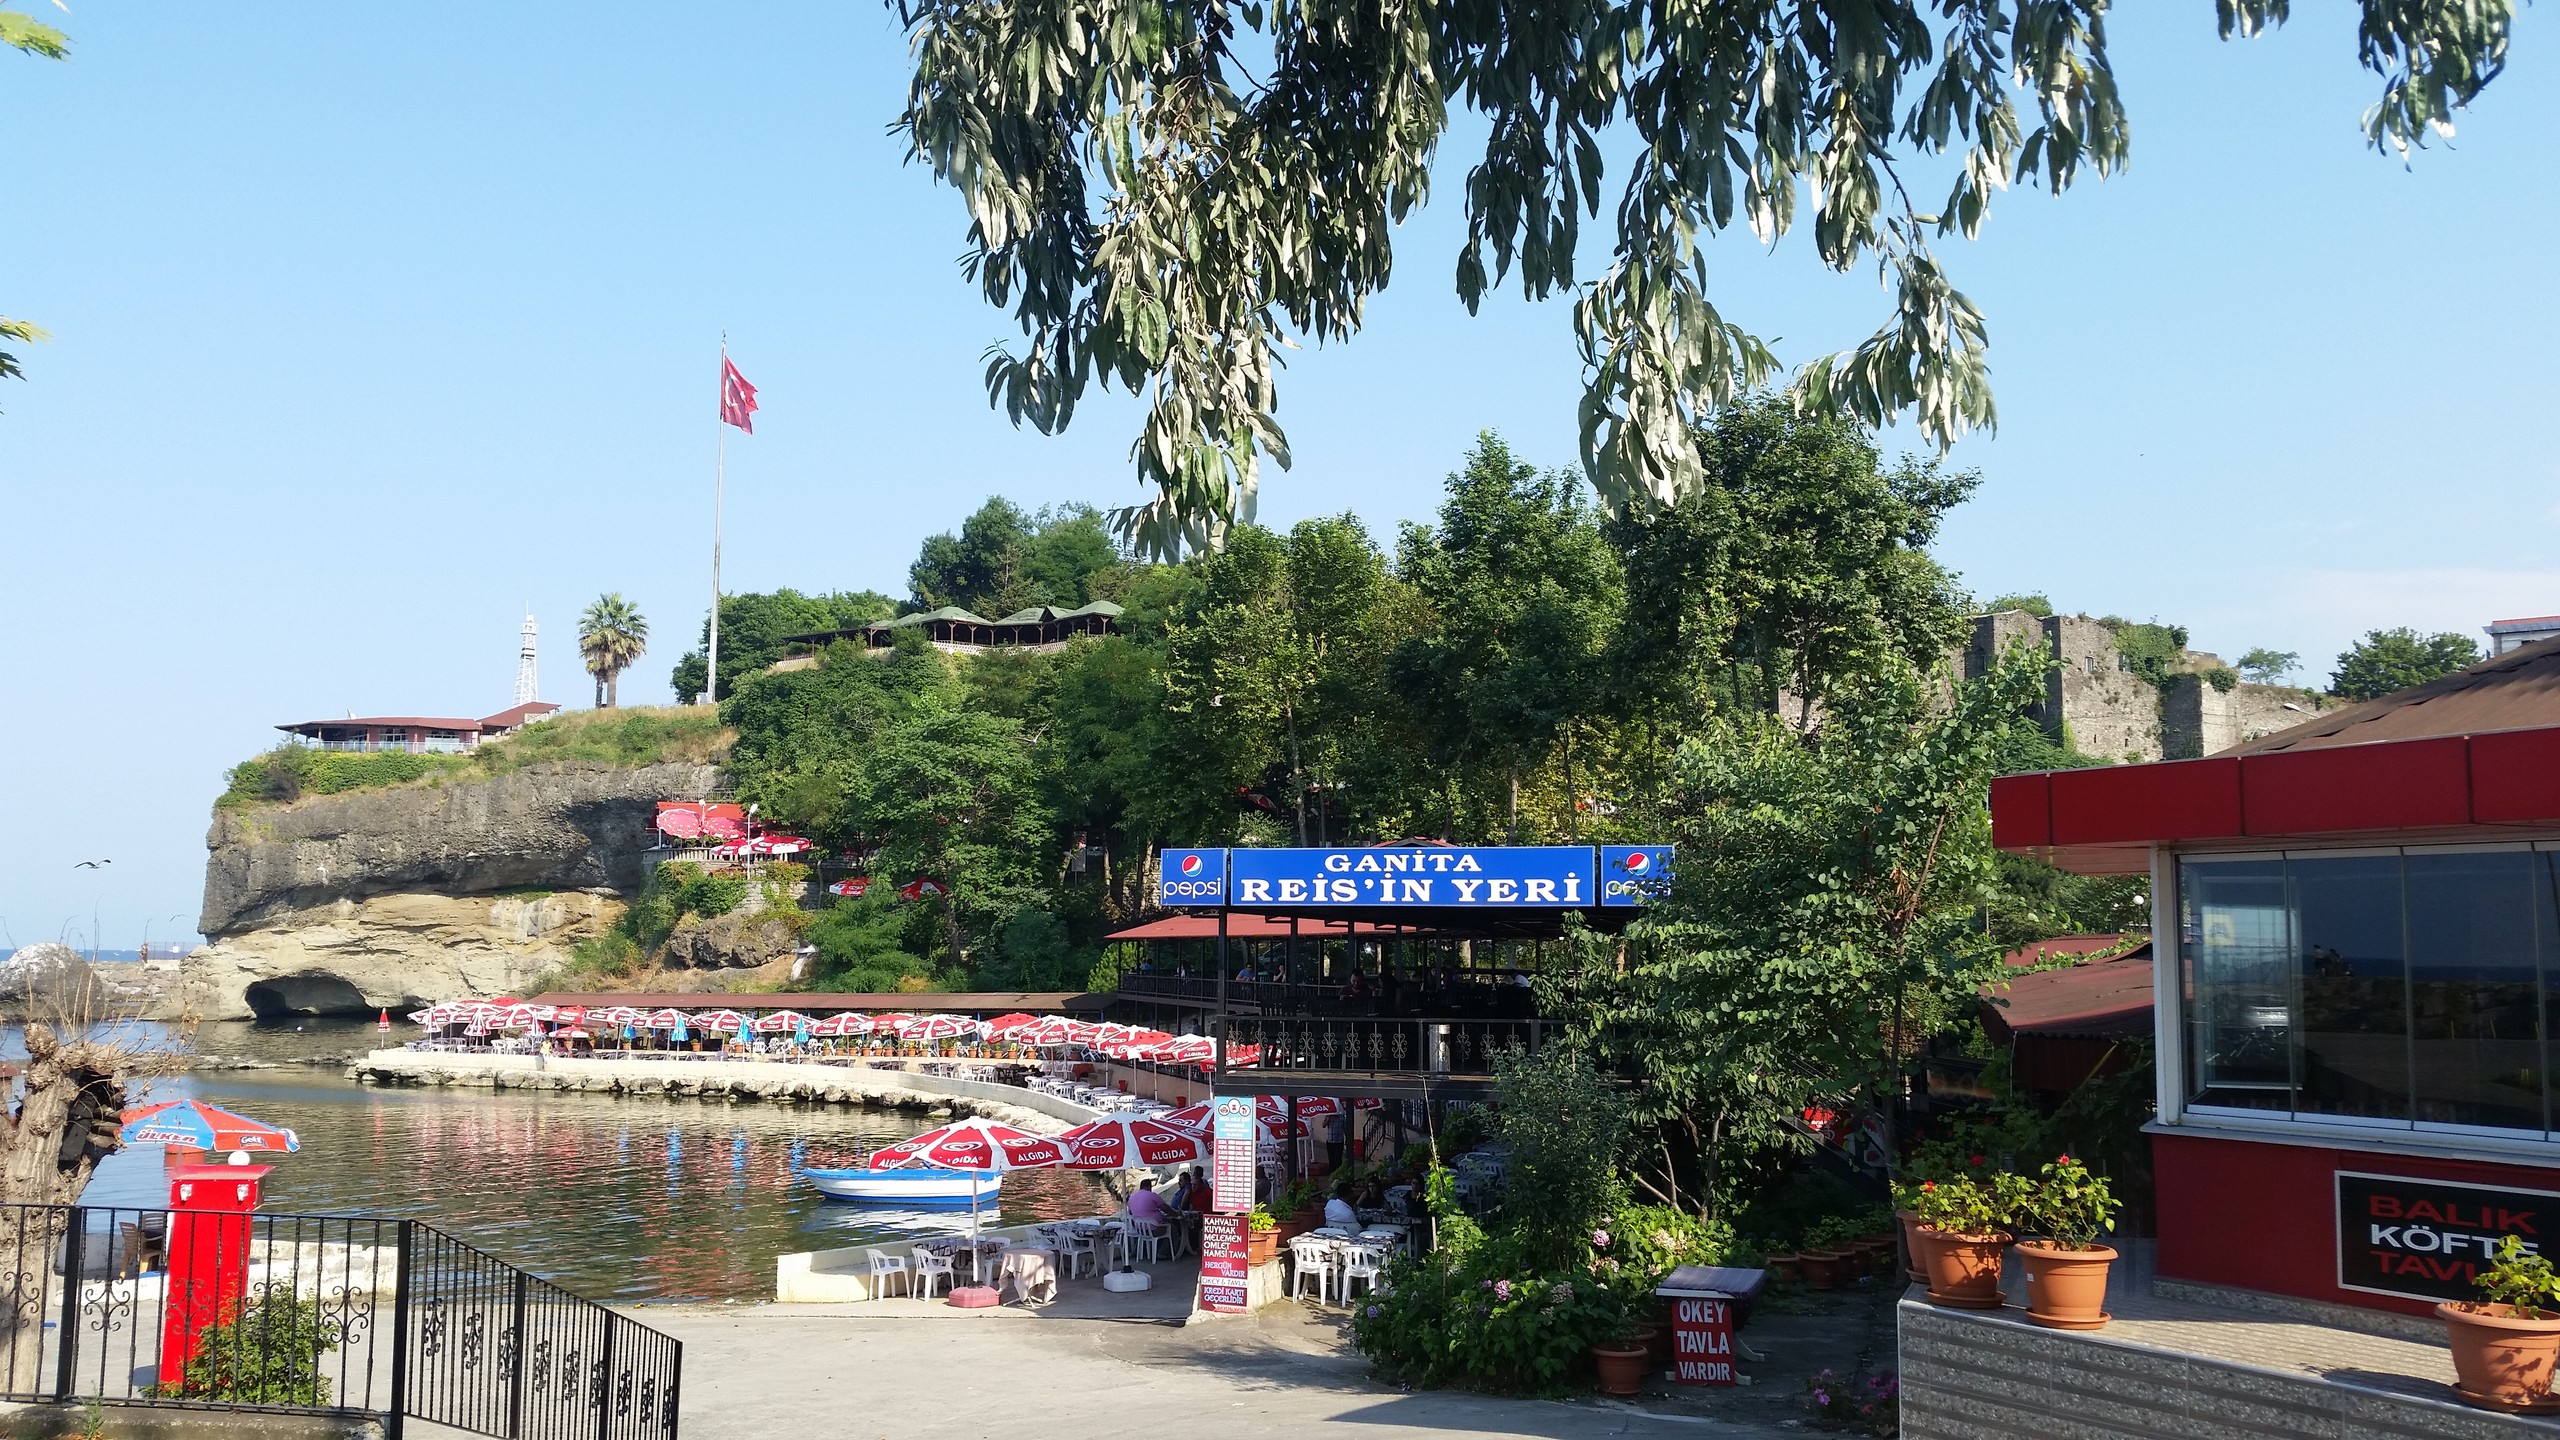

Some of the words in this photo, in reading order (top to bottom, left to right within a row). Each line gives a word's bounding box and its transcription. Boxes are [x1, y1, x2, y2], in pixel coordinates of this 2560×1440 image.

[1325, 850, 1482, 872] GANİTA
[1163, 877, 1222, 899] pepsi
[1451, 872, 1581, 902] YERİ
[1204, 1217, 1239, 1227] KAHVALTI
[2369, 1195, 2538, 1235] BALIK
[1204, 1225, 1236, 1234] KUYMAK
[1203, 1241, 1230, 1250] OMLET
[1204, 1233, 1242, 1243] MELEMEN
[1229, 1250, 1248, 1260] TAVA
[1221, 1269, 1246, 1278] VARDIR
[1227, 1279, 1247, 1287] TAVLA
[1679, 1299, 1726, 1324] OKEY
[1677, 1330, 1731, 1355] TAVLA
[1679, 1361, 1731, 1381] VARDIR
